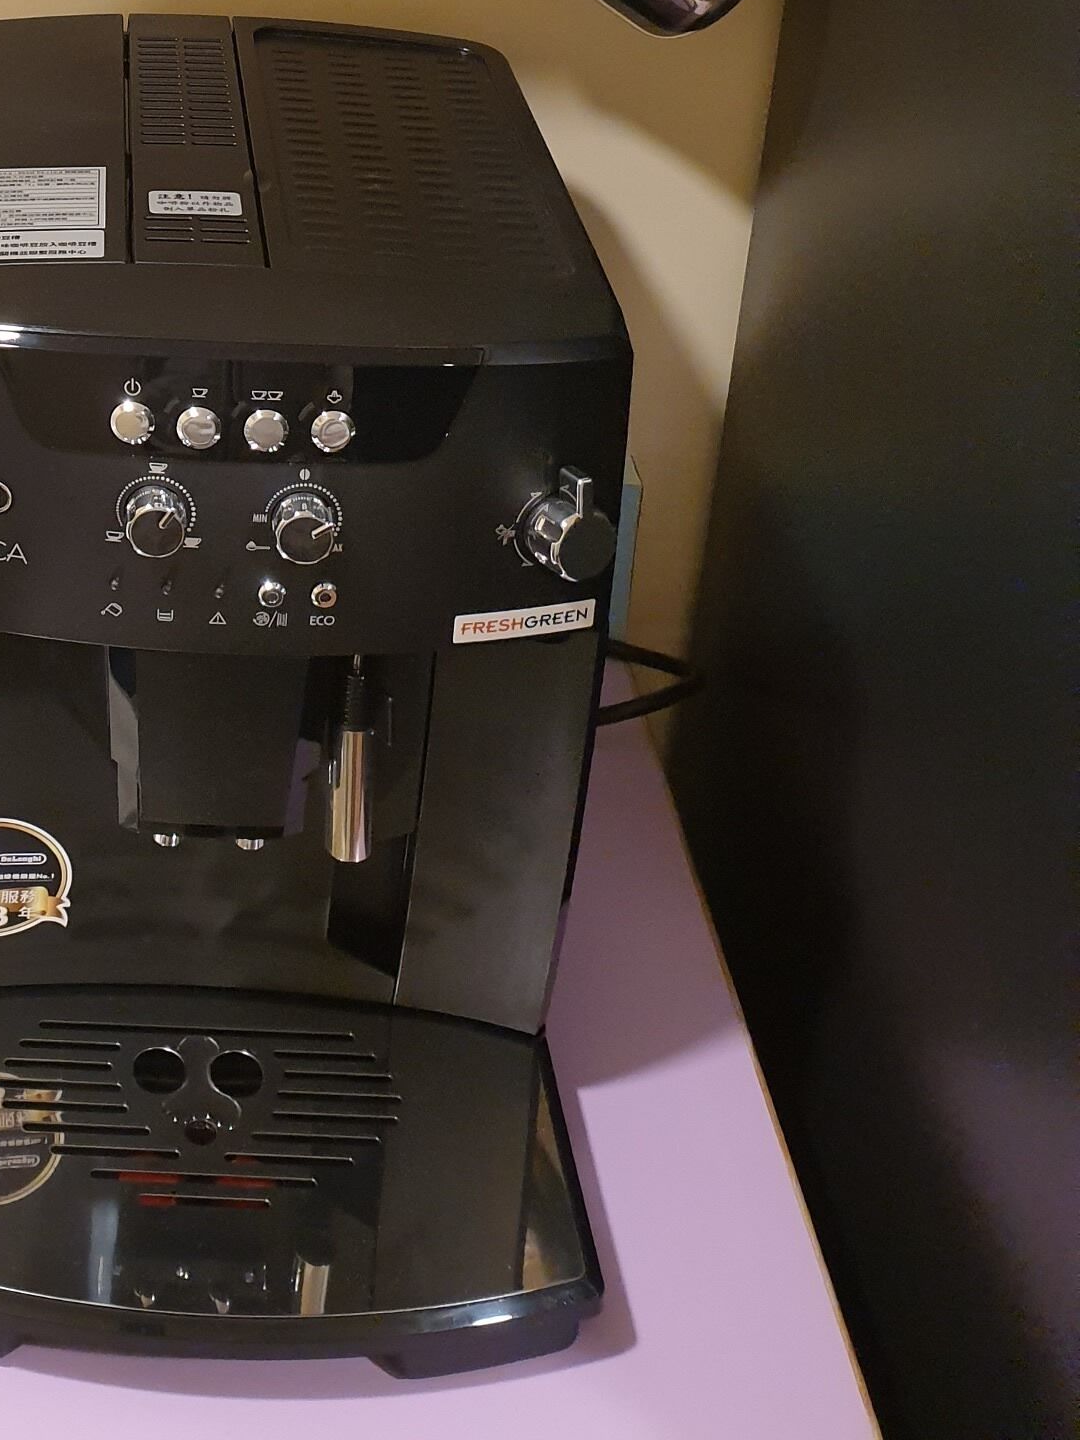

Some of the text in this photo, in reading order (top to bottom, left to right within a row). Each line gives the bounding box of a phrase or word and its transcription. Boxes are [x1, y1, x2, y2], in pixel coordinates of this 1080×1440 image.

[252, 513, 269, 523] MIN
[309, 615, 336, 626] ECO
[460, 607, 589, 636] FRESHGREEN
